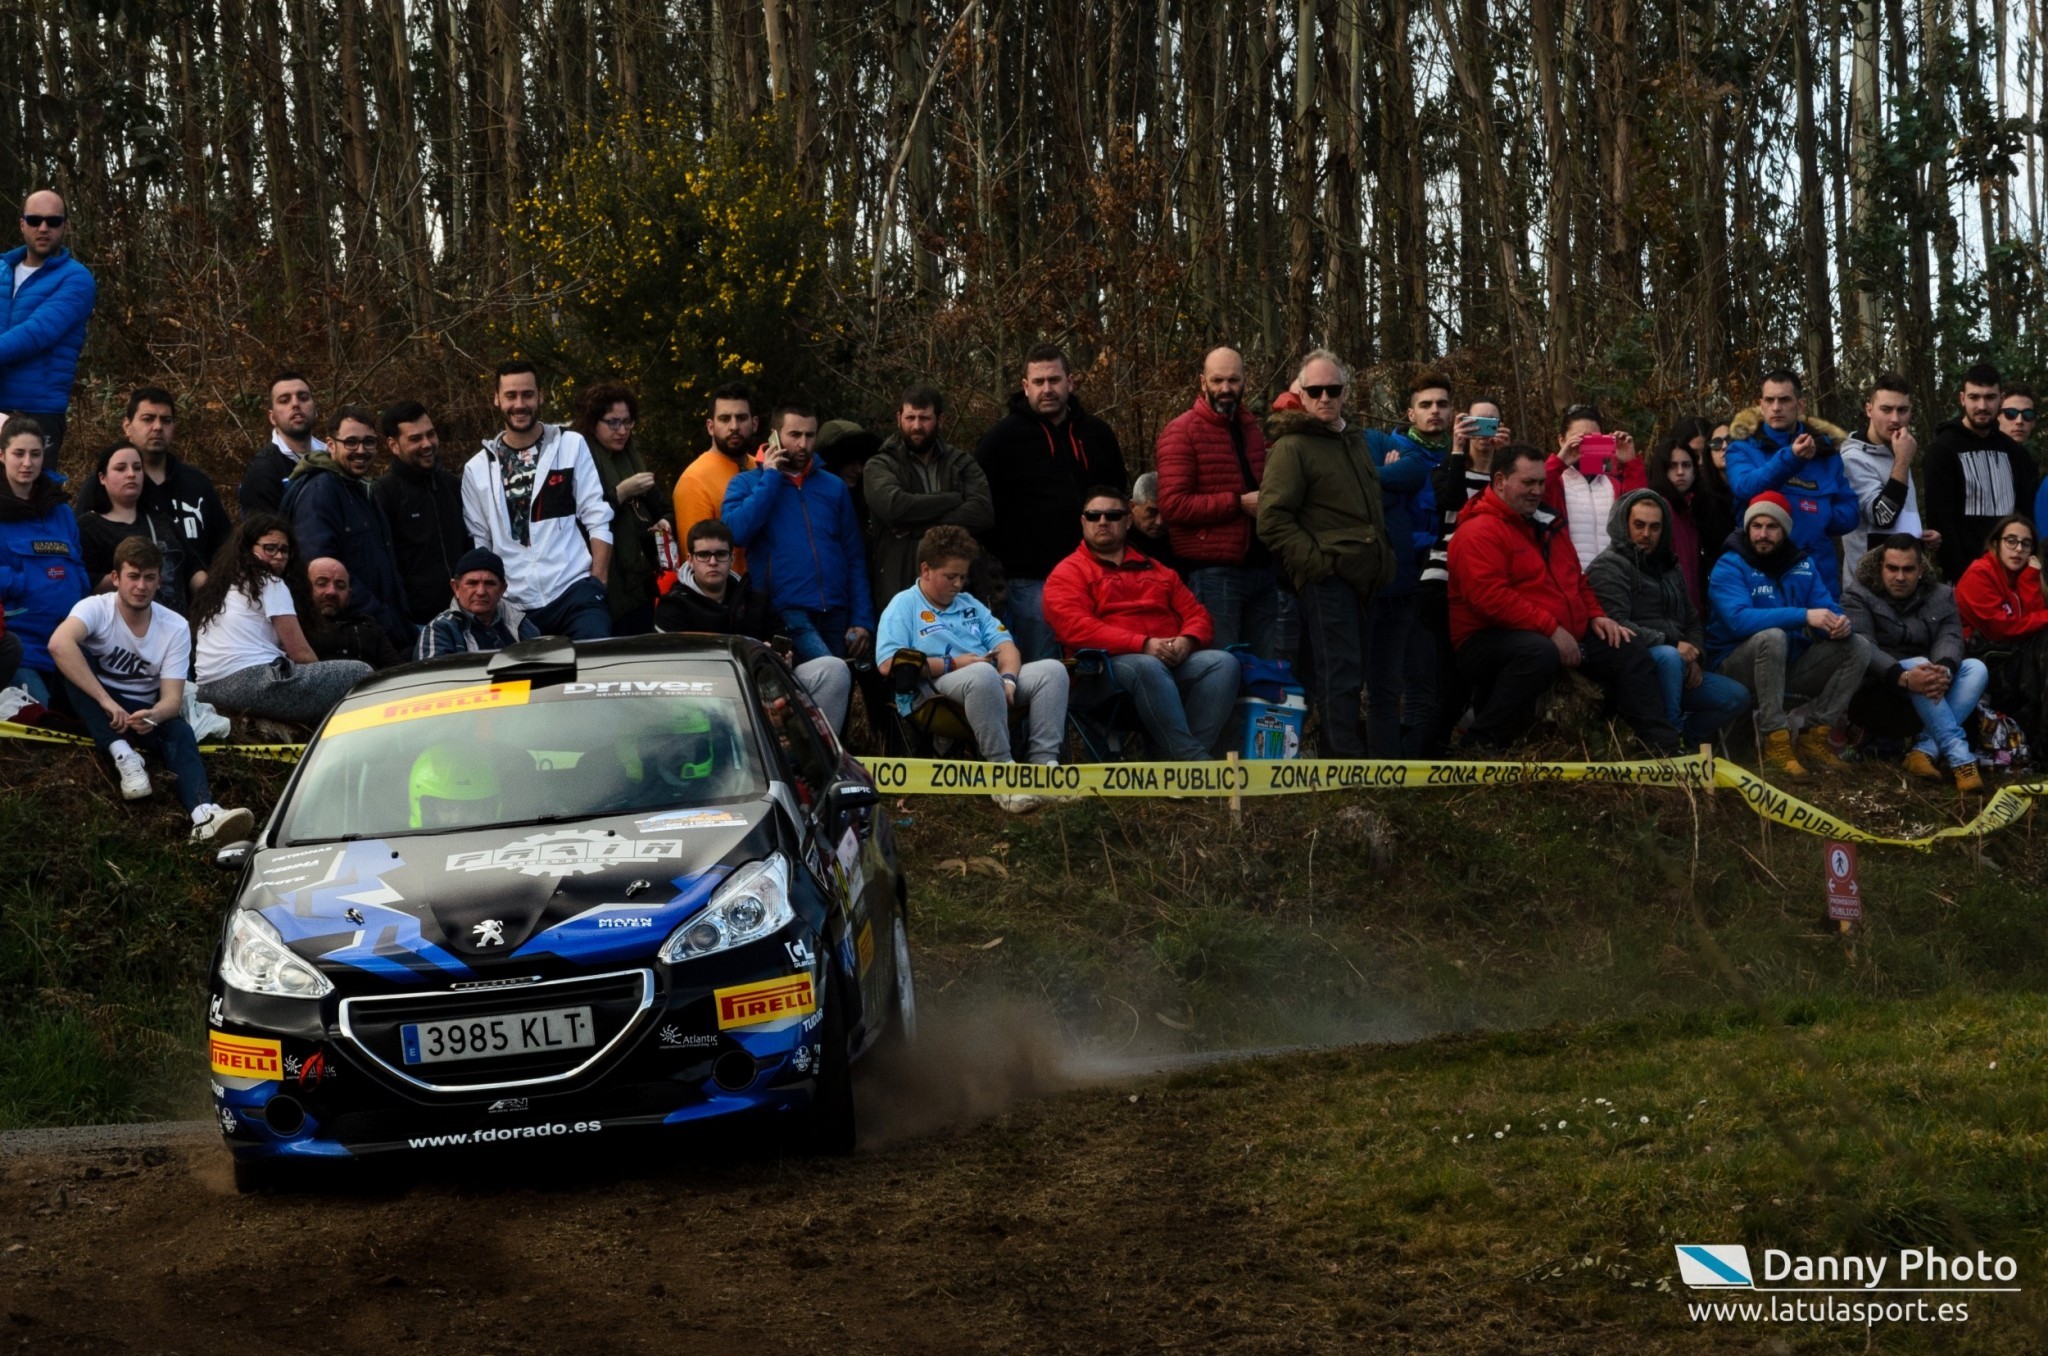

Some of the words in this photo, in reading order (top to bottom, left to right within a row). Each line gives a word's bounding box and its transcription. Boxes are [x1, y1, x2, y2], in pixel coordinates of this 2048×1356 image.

[107, 646, 151, 674] NIKE
[384, 688, 502, 718] PIRELLI
[931, 763, 986, 787] ZONA
[992, 765, 1080, 789] PUBLICO
[1104, 767, 1158, 790] ZONA
[1270, 765, 1321, 788] ZONA
[1326, 765, 1407, 787] PUBLICO
[1427, 765, 1478, 784] ZONA
[1482, 765, 1563, 784] PUBLICO
[1583, 766, 1633, 783] ZONA
[1738, 775, 1785, 820] ZONA
[720, 980, 814, 1021] PIRELLI
[803, 1007, 824, 1033] TUDOR
[427, 1021, 508, 1056] 3985
[521, 1013, 582, 1049] KLT
[682, 1034, 718, 1044] Atlantic
[408, 1120, 602, 1149] www.fdorado.es
